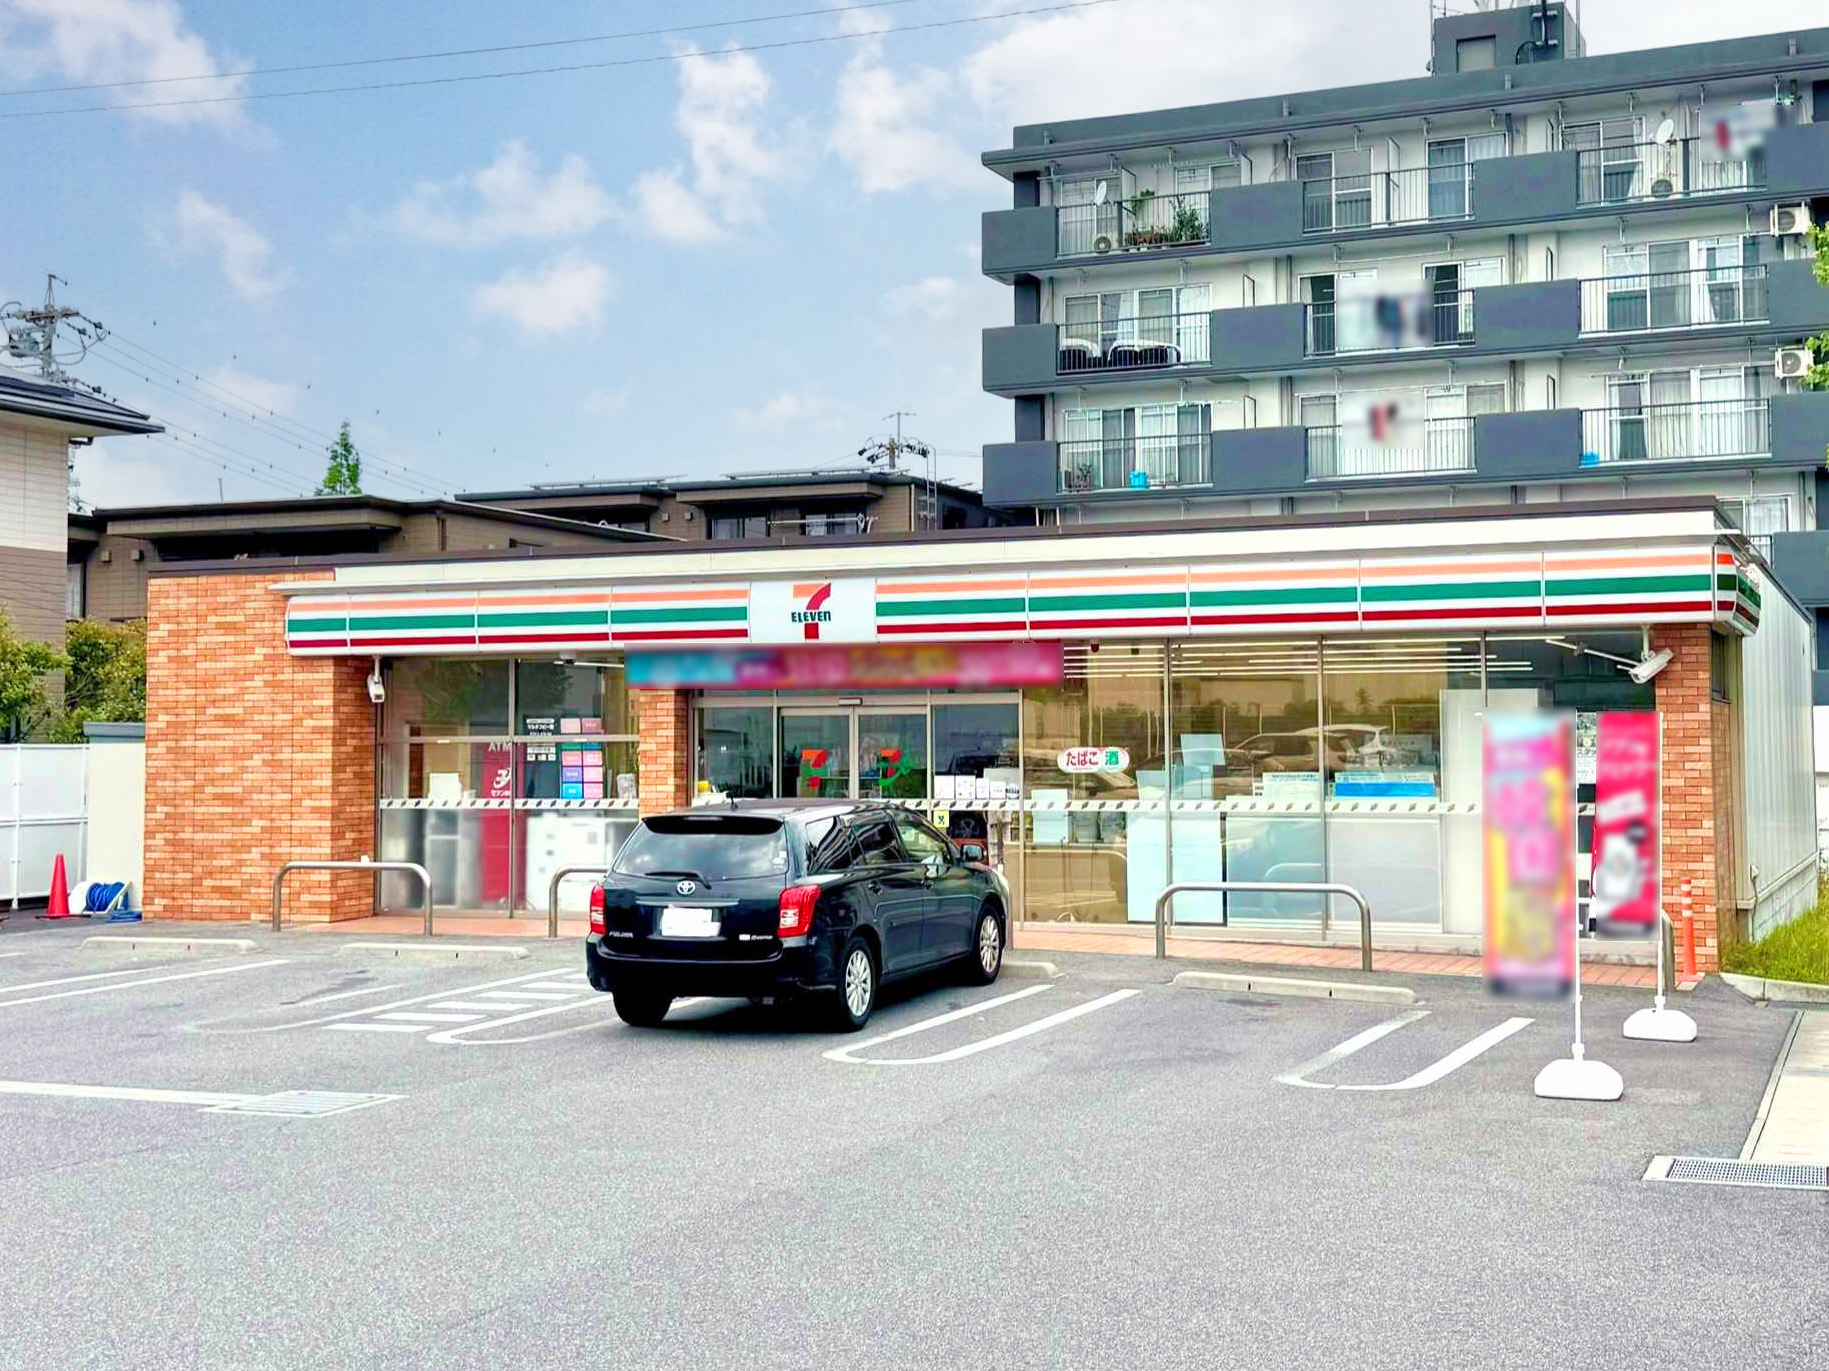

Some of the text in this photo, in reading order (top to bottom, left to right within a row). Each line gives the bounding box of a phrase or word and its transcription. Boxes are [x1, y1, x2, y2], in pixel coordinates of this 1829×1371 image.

[793, 582, 831, 640] 7
[1066, 750, 1119, 766] たばこ 酒
